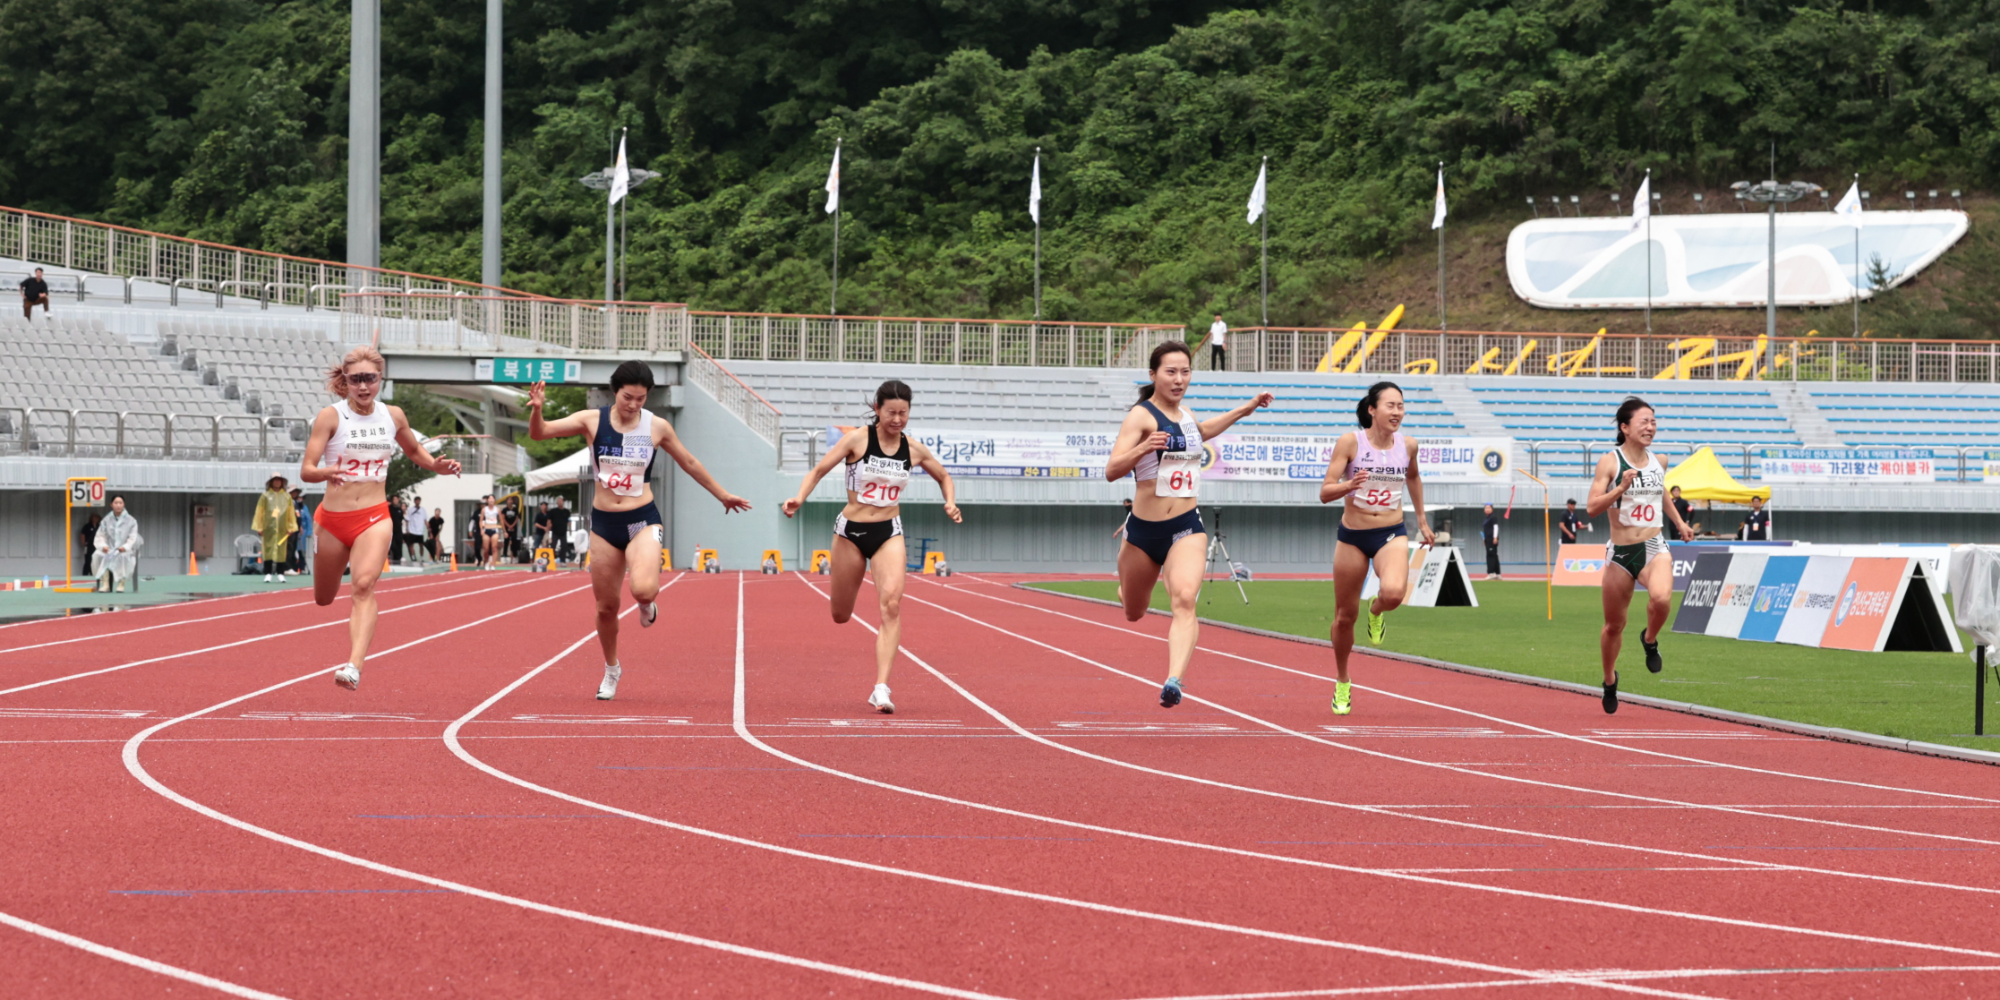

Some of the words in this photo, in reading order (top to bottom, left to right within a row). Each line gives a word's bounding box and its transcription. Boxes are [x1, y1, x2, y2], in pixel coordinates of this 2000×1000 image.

[597, 445, 648, 459] 가평군청
[1222, 444, 1267, 461] 정선군에
[1272, 445, 1317, 462] 방문하신
[1419, 447, 1475, 463] 환영합니다
[345, 459, 384, 476] 217
[607, 472, 632, 491] 64
[1170, 470, 1193, 491] 61
[862, 481, 900, 501] 210
[1366, 489, 1392, 507] 52
[1631, 504, 1655, 521] 40
[1683, 579, 1722, 607] DESCENTE
[1849, 590, 1892, 617] 정선군체육회
